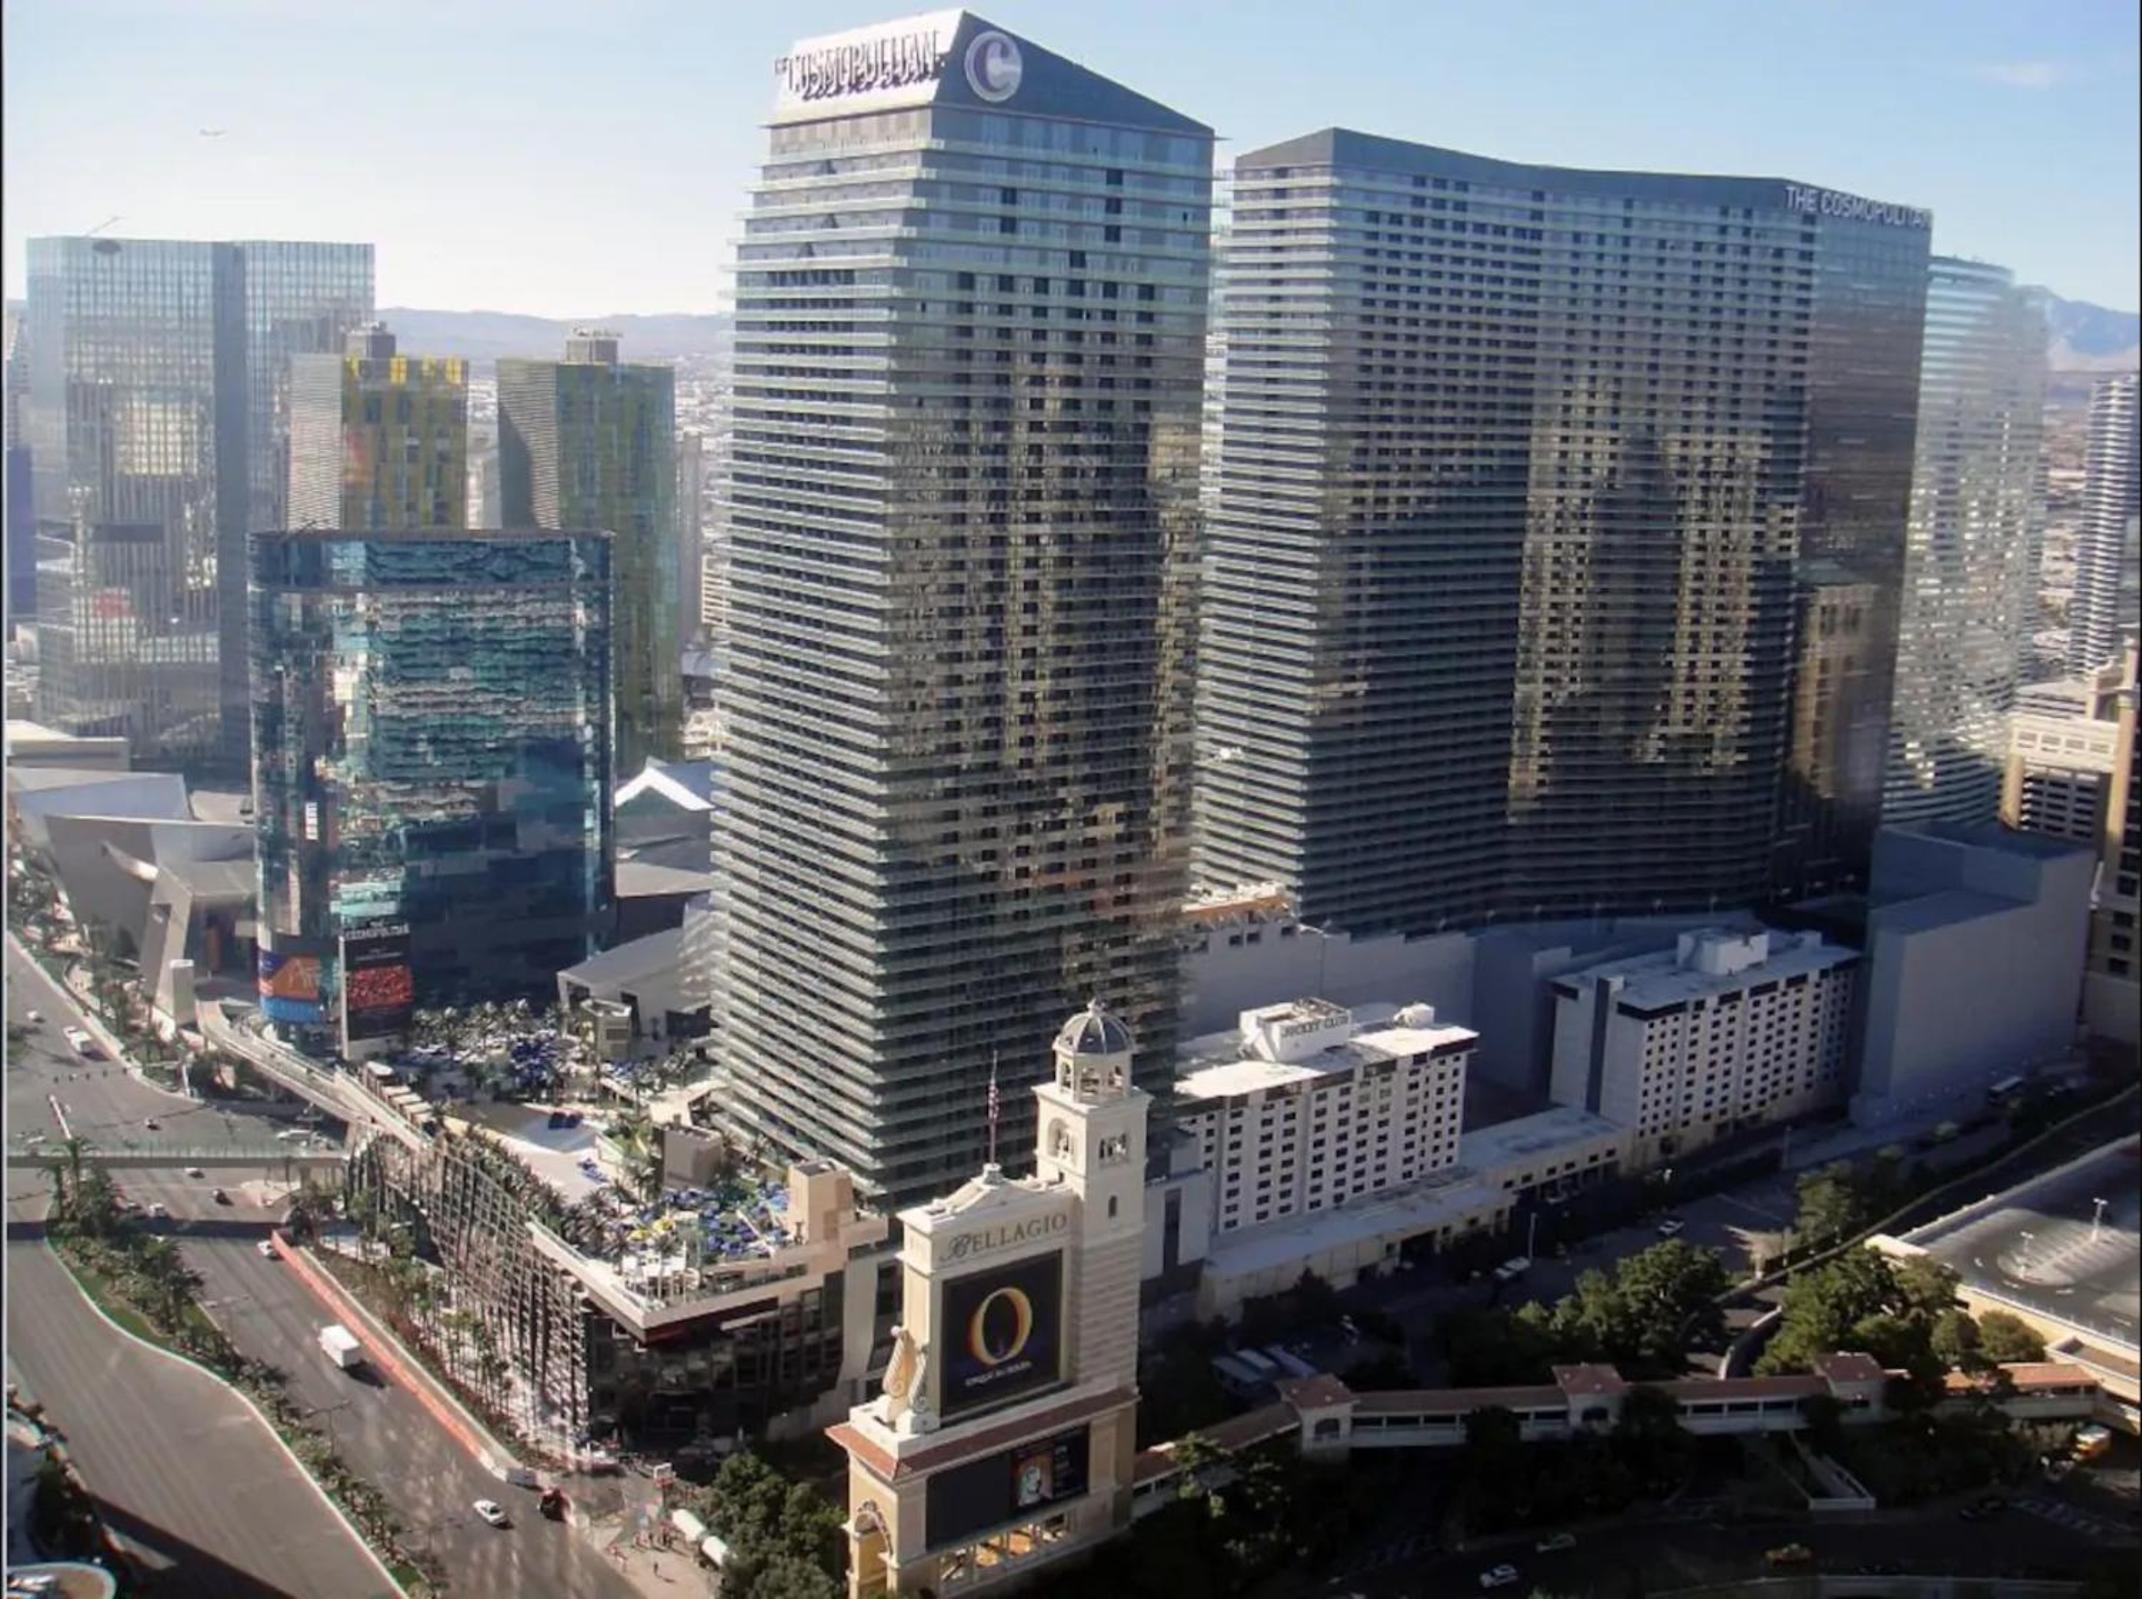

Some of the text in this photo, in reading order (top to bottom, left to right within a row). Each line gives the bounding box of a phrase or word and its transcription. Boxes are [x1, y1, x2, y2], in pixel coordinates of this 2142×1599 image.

[1785, 186, 1818, 213] THE
[949, 1213, 1067, 1259] BELLAGIO
[967, 1286, 1033, 1366] O
